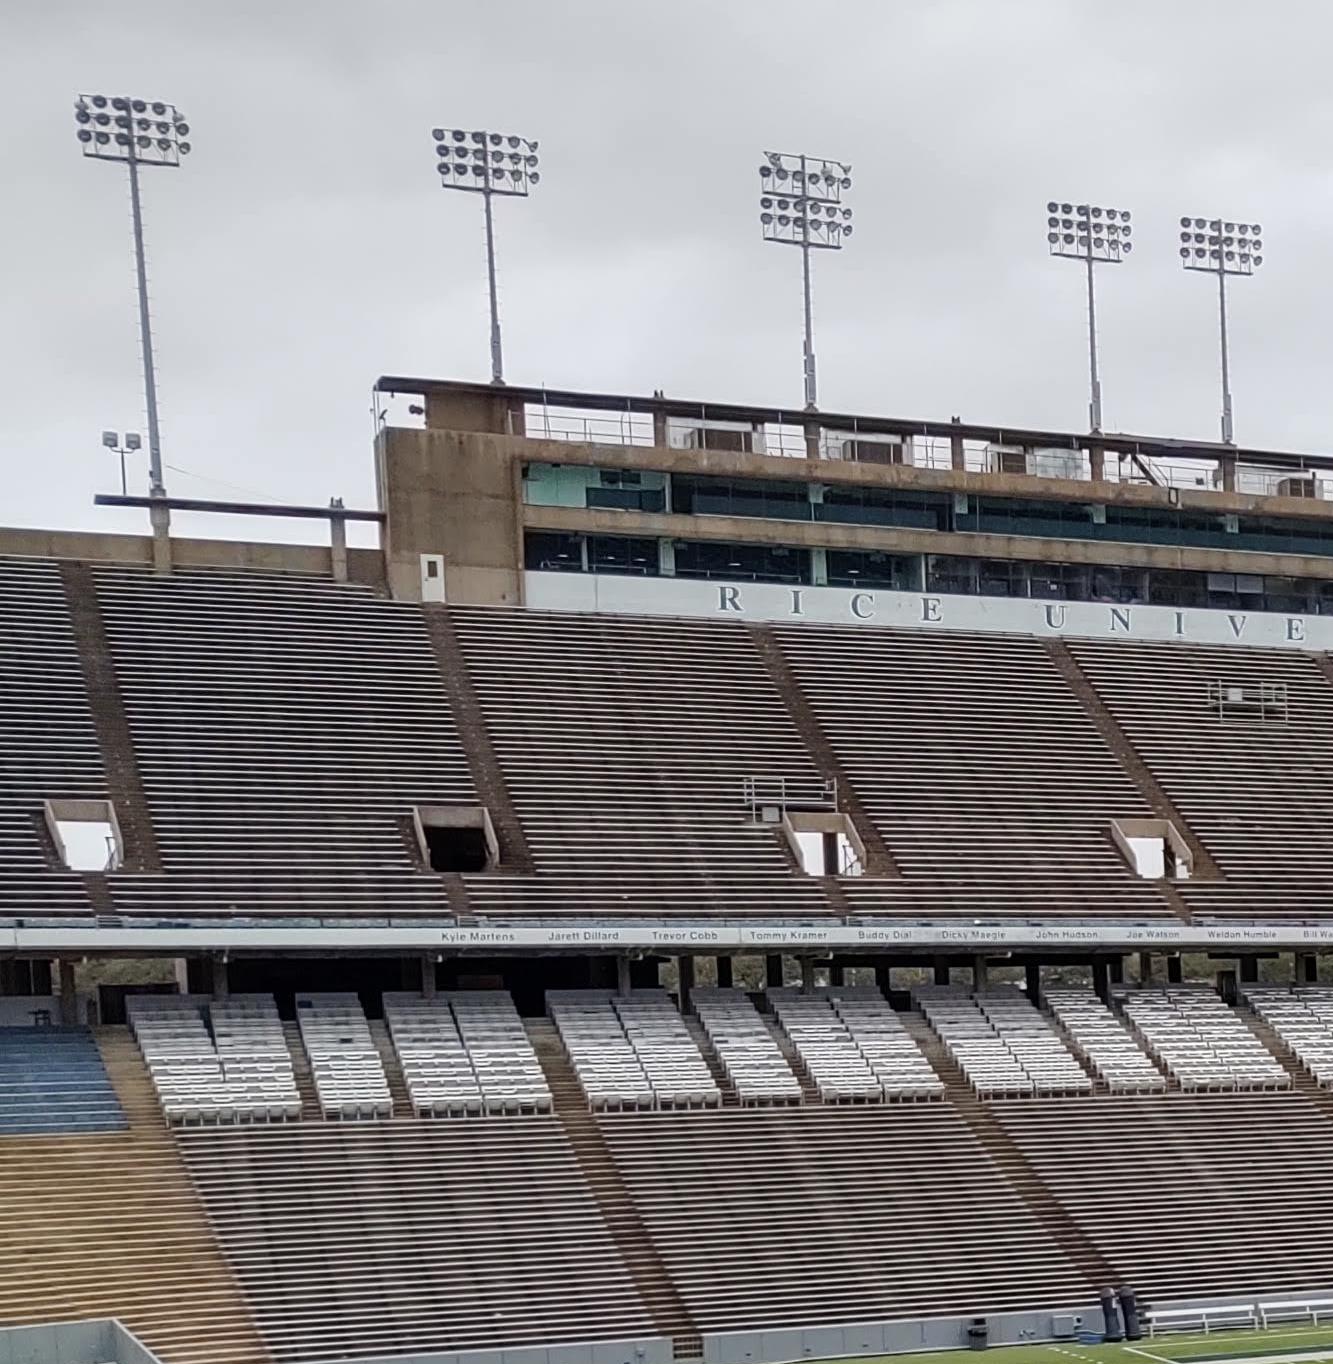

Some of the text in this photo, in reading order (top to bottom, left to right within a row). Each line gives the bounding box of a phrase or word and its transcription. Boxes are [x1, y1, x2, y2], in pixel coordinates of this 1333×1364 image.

[717, 585, 943, 623] RICE
[441, 932, 516, 942] Kyle Martens
[547, 931, 620, 941] Jarett Dillard
[652, 931, 718, 940] Trevor Cobb
[751, 931, 827, 941] Tommy Kramer
[858, 930, 912, 940] Buddy Dial
[1036, 930, 1098, 939] John Hudson
[1126, 930, 1180, 939] Joe Watson
[1207, 930, 1277, 939] Weldon Humble
[1303, 930, 1318, 939] Bill
